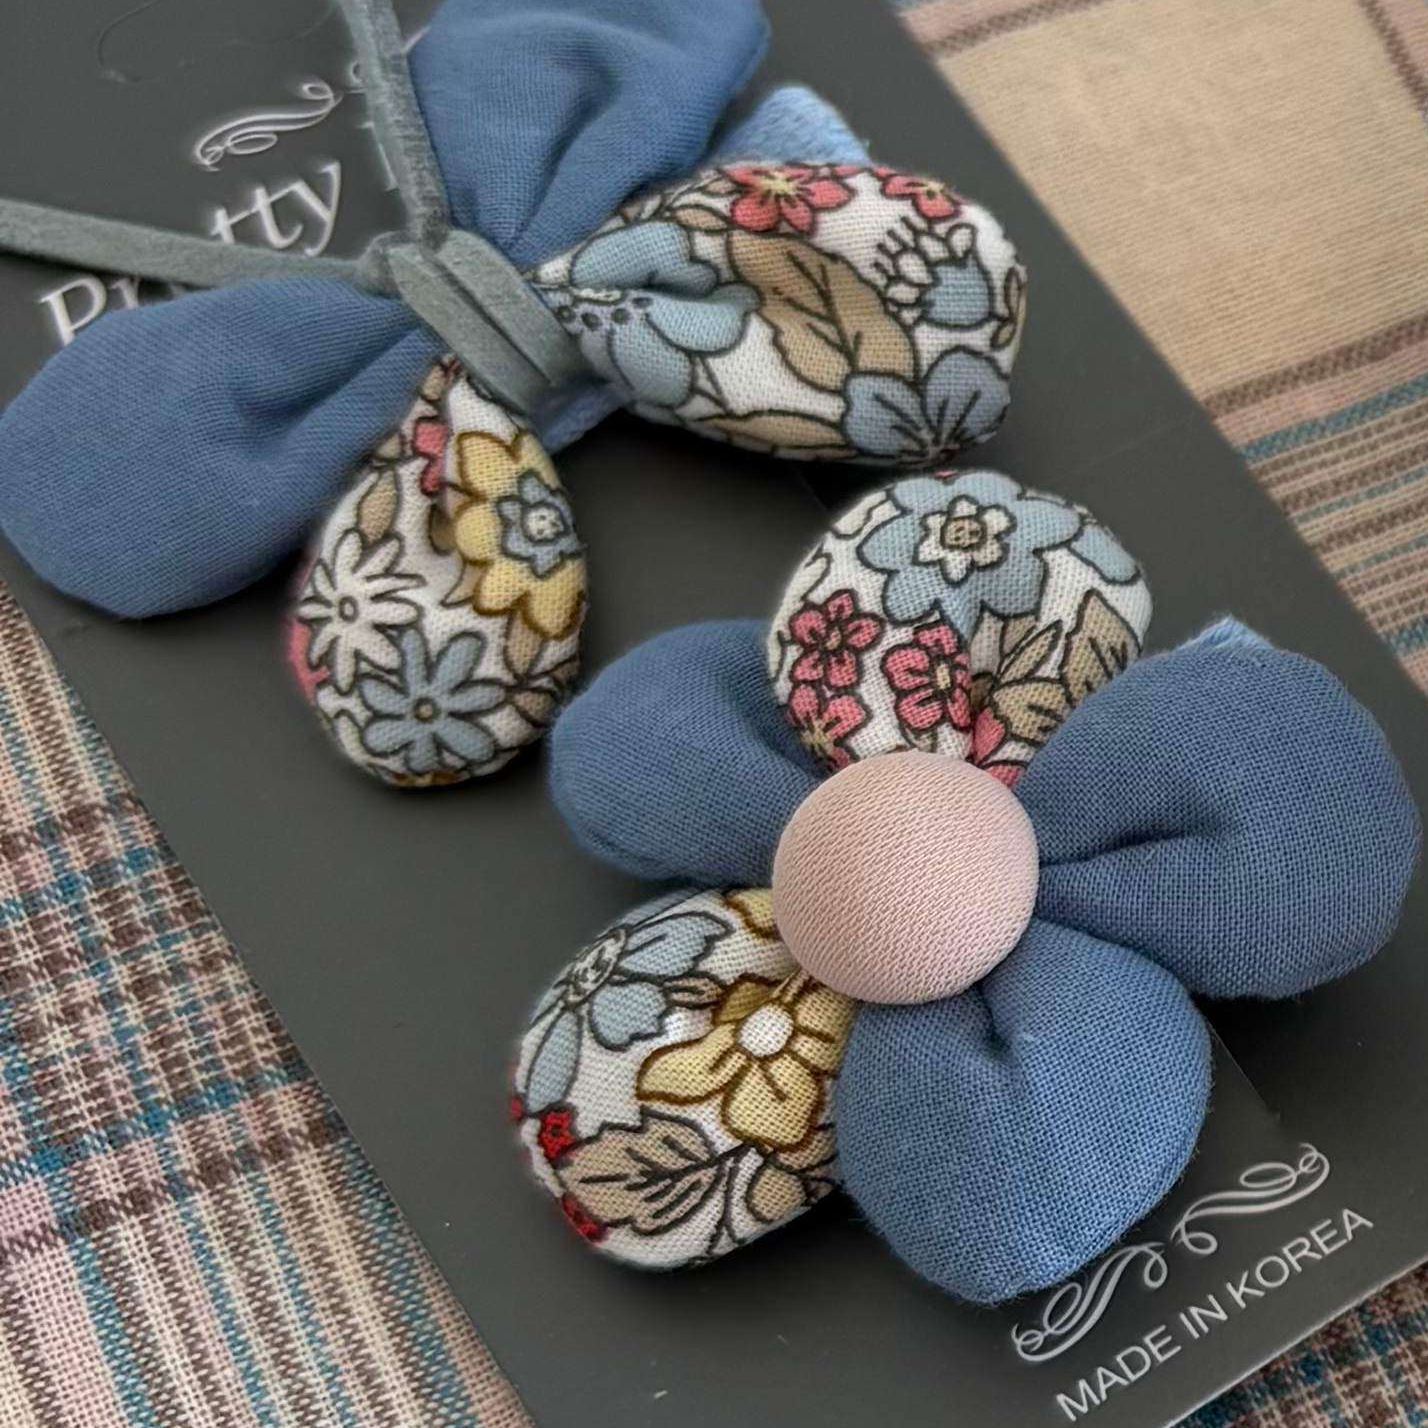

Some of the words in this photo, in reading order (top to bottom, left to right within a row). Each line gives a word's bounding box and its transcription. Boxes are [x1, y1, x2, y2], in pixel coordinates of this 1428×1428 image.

[39, 161, 342, 345] Prtty
[1055, 1324, 1182, 1422] MADE
[1179, 1294, 1229, 1340] IN
[1226, 1208, 1374, 1308] KOREA
